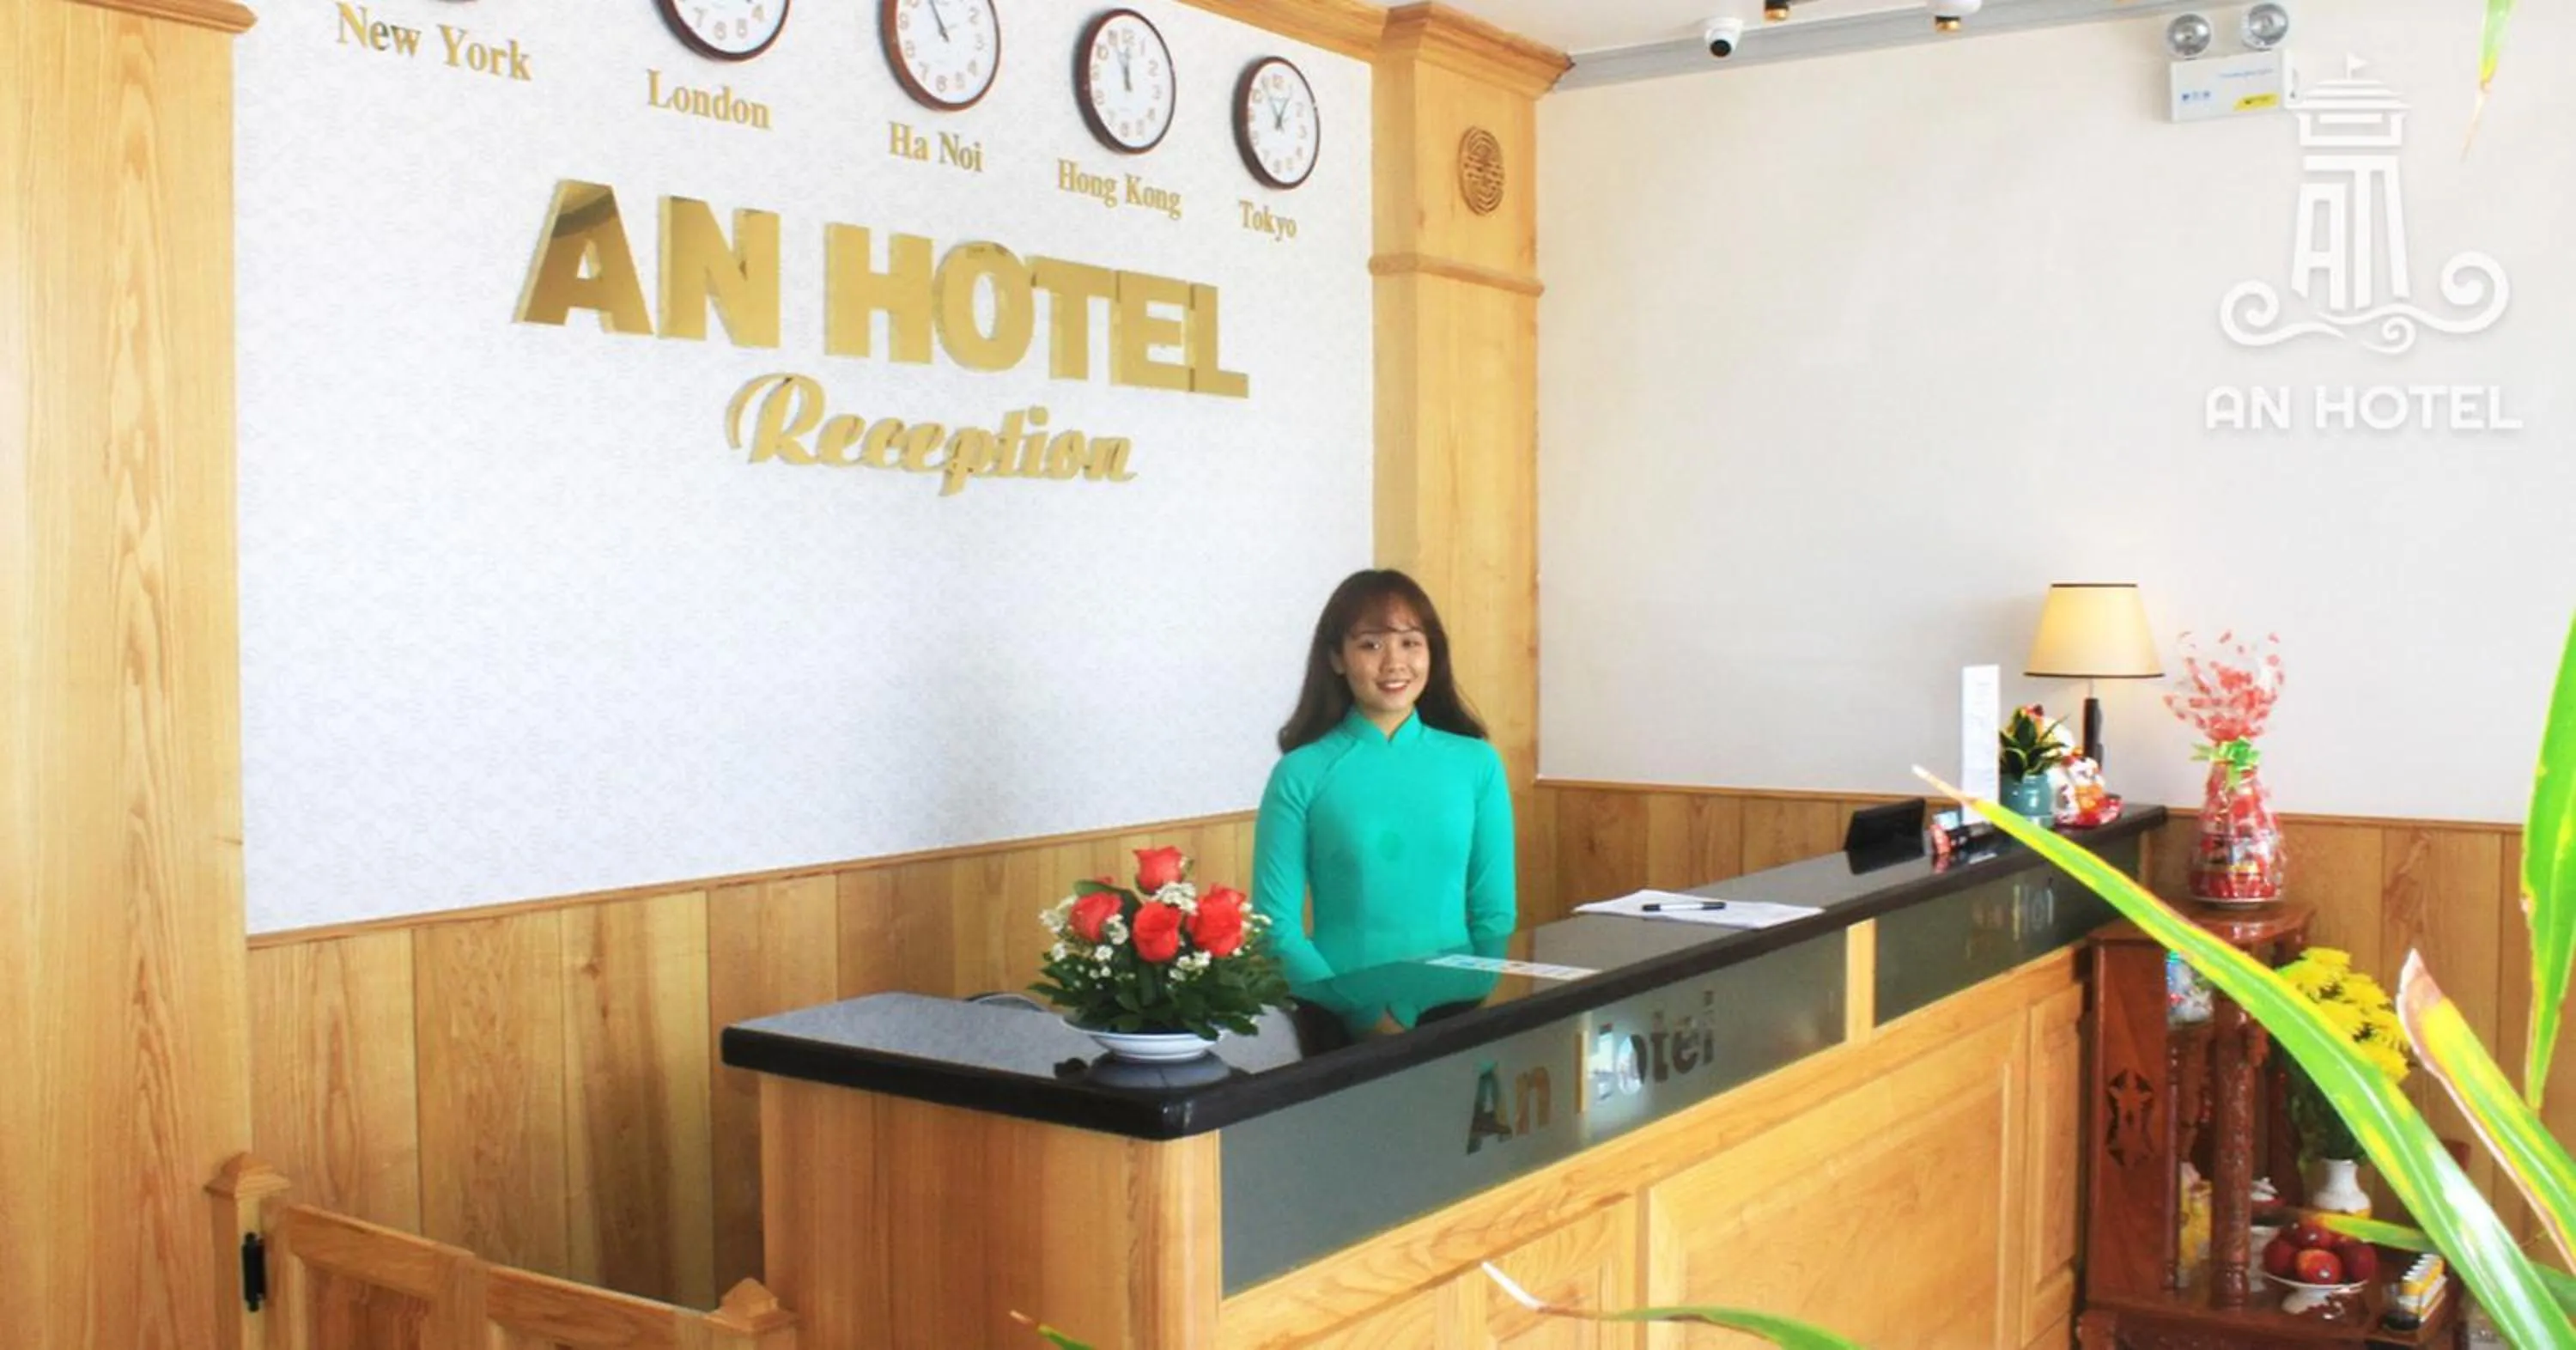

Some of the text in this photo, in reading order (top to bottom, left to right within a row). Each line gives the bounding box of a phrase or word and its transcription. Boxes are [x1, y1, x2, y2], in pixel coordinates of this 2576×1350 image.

[336, 2, 532, 81] New York
[692, 6, 709, 28] 7
[647, 68, 774, 130] London
[888, 120, 984, 173] Ha Noi
[1058, 158, 1182, 220] Hong Kong
[1239, 198, 1298, 241] Tokyo
[513, 179, 1249, 398] AN HOTEL
[725, 372, 1139, 497] Reception
[1466, 1060, 1552, 1155] An
